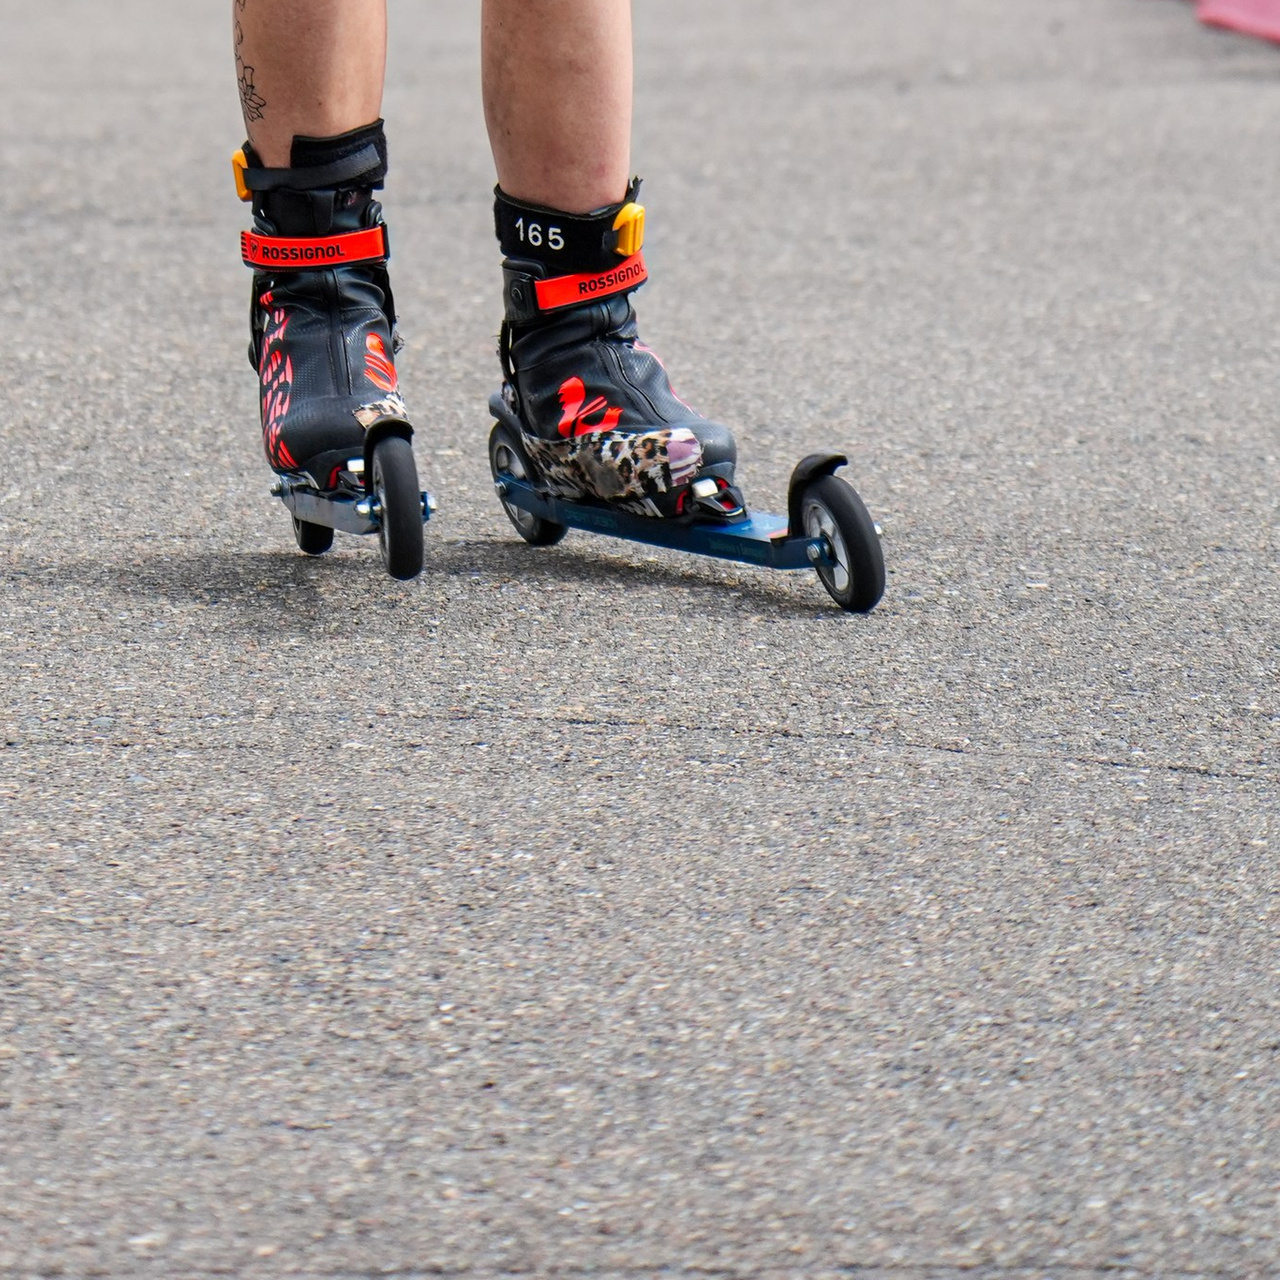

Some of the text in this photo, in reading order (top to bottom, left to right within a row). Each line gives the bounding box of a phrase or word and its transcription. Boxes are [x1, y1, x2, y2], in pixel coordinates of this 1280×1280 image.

[515, 217, 565, 251] 165
[262, 244, 345, 260] ROSSIGNOL
[578, 261, 645, 295] ROSSIGNOL
